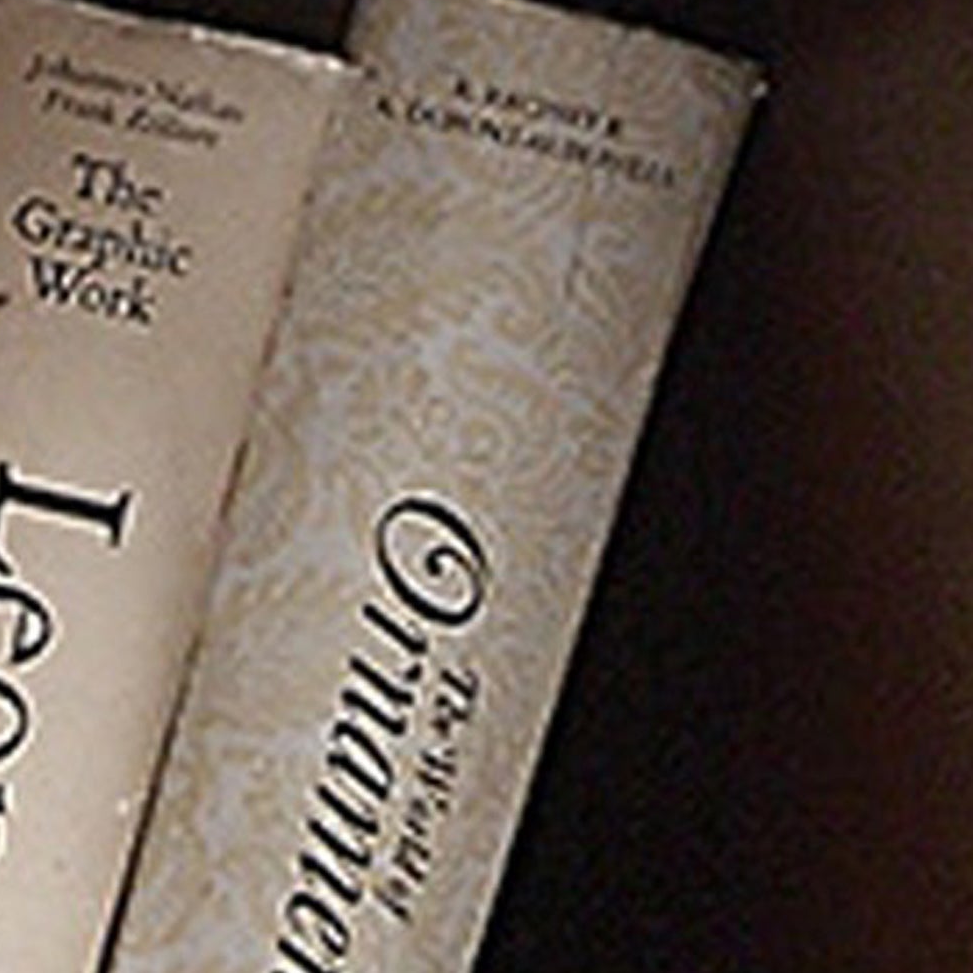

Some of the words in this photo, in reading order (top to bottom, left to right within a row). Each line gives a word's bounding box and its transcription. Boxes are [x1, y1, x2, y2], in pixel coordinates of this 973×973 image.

[72, 153, 163, 214] The
[11, 196, 193, 278] Graphic
[29, 257, 157, 324] Work
